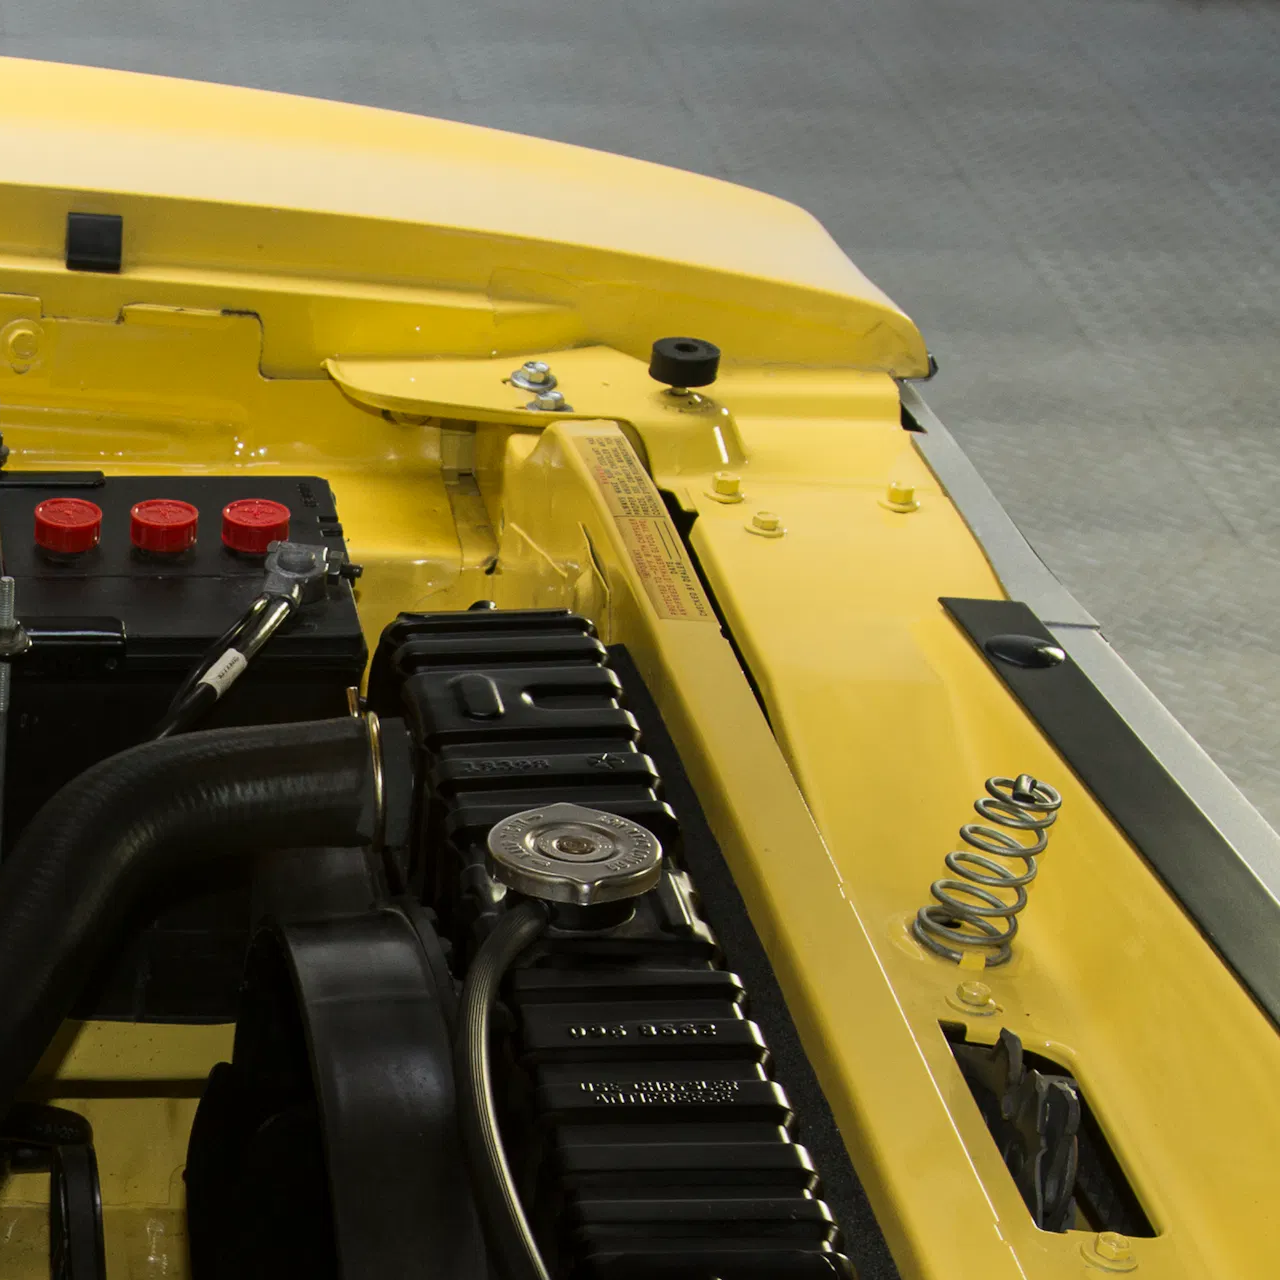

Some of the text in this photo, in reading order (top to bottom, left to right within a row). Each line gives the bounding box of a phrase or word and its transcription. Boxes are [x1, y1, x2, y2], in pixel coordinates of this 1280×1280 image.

[629, 519, 645, 543] CHRYSLER
[641, 545, 651, 556] WITH
[666, 562, 678, 574] DATE
[675, 562, 691, 582] DEALER
[658, 585, 676, 615] PROTECTED
[689, 592, 707, 616] CHECKED
[579, 1078, 740, 1093] USE CHRYSLER
[594, 1091, 736, 1105] ANTIFREEZE
